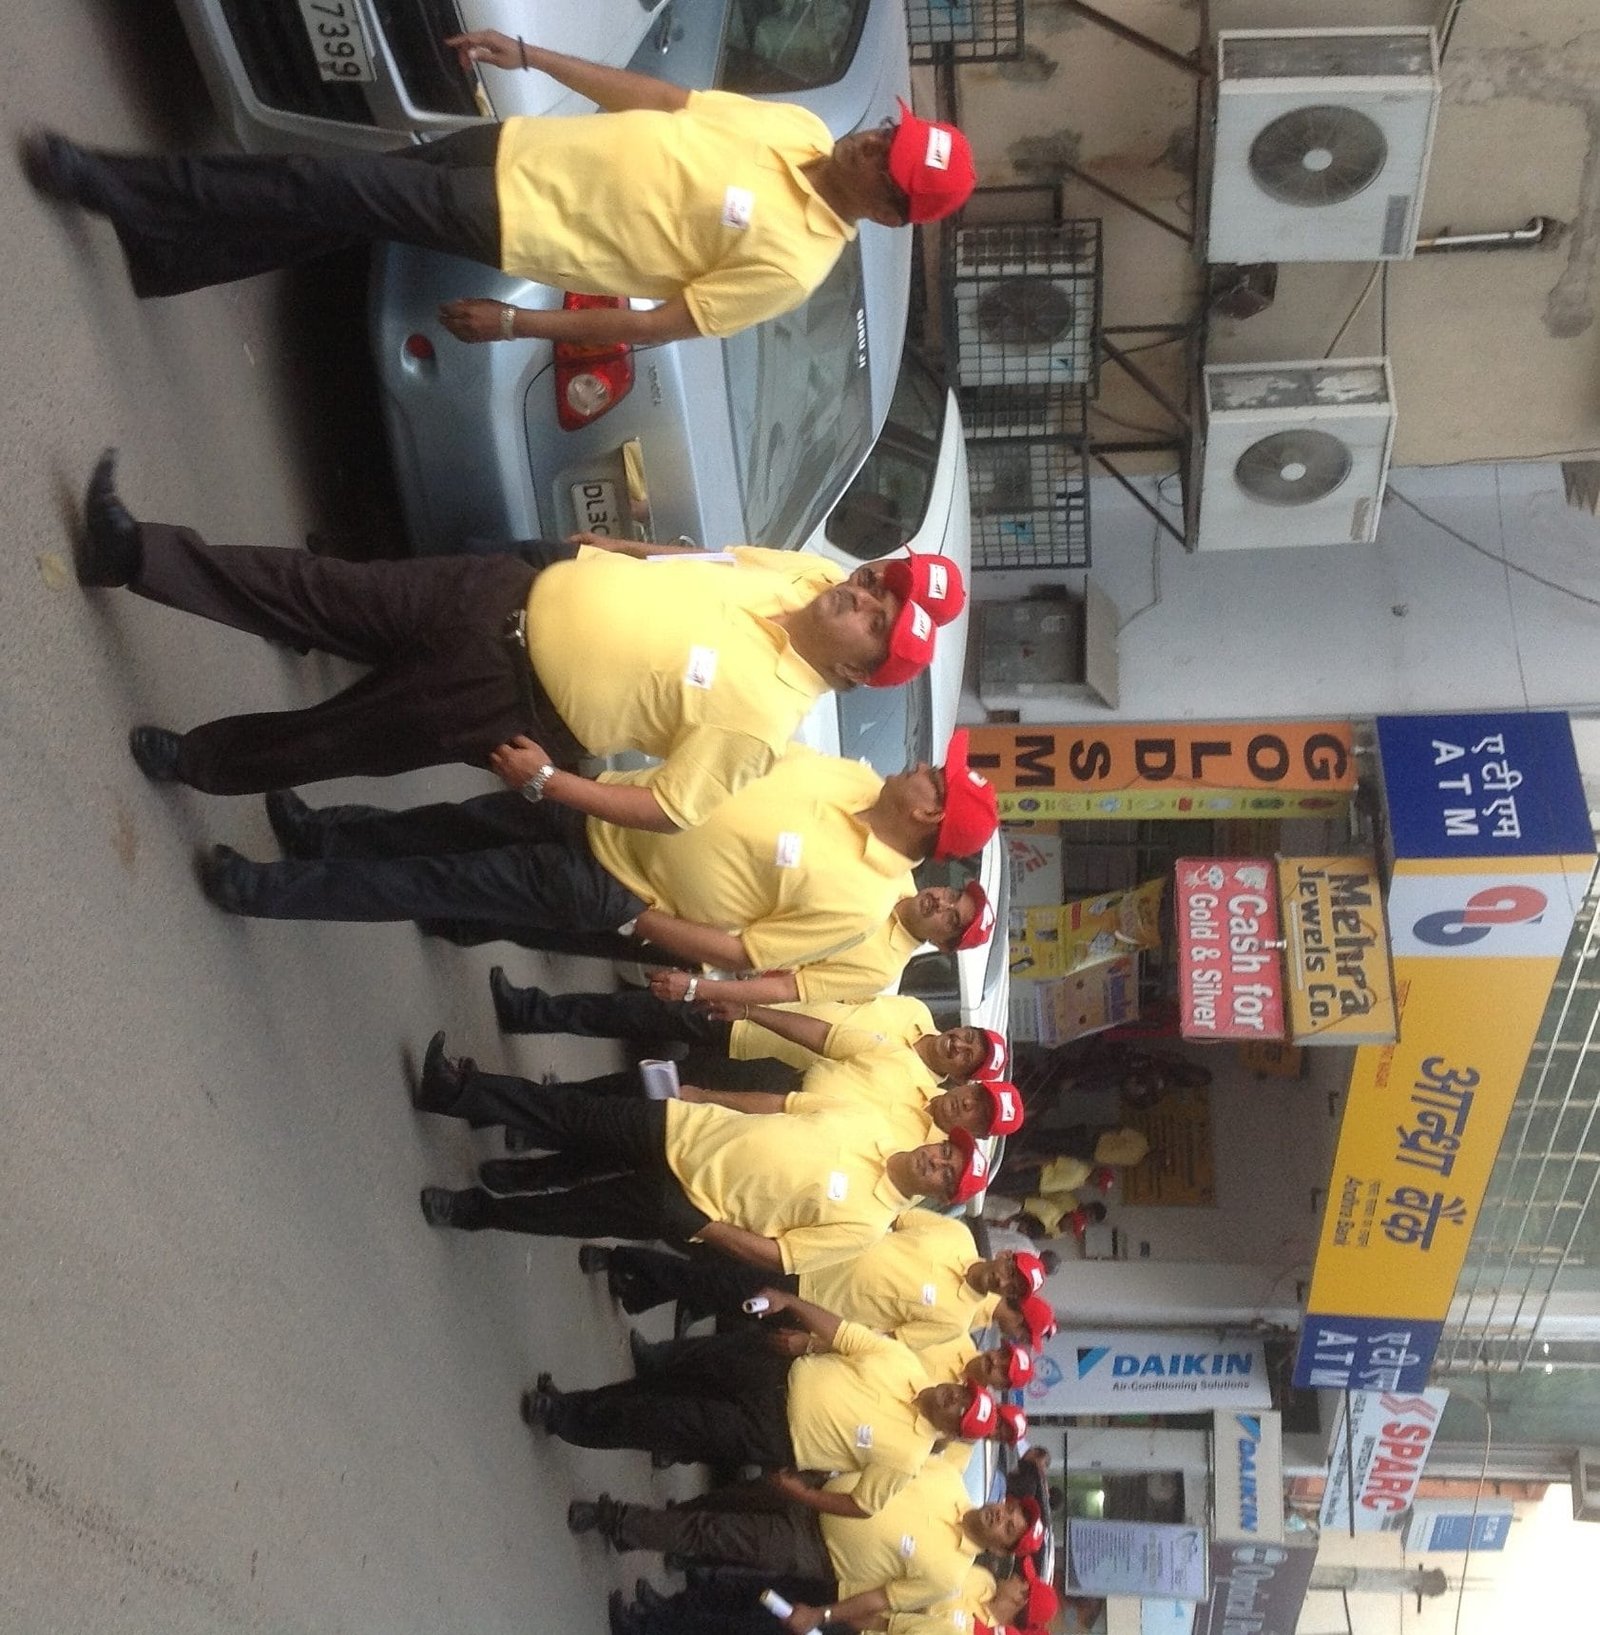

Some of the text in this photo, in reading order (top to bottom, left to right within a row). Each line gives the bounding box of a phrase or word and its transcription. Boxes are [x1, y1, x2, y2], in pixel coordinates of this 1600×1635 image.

[310, 3, 361, 76] 7399
[1432, 739, 1479, 836] ATM
[1189, 893, 1223, 1030] Gold & Silver
[1229, 894, 1273, 1031] Cash for
[1298, 866, 1337, 1026] Jewels Co.
[1328, 873, 1375, 1015] Mehra
[1112, 1353, 1252, 1376] DAIKIN
[1310, 1329, 1358, 1386] ATM
[1238, 1438, 1258, 1532] DAIKIN
[1361, 1422, 1432, 1513] SPARC
